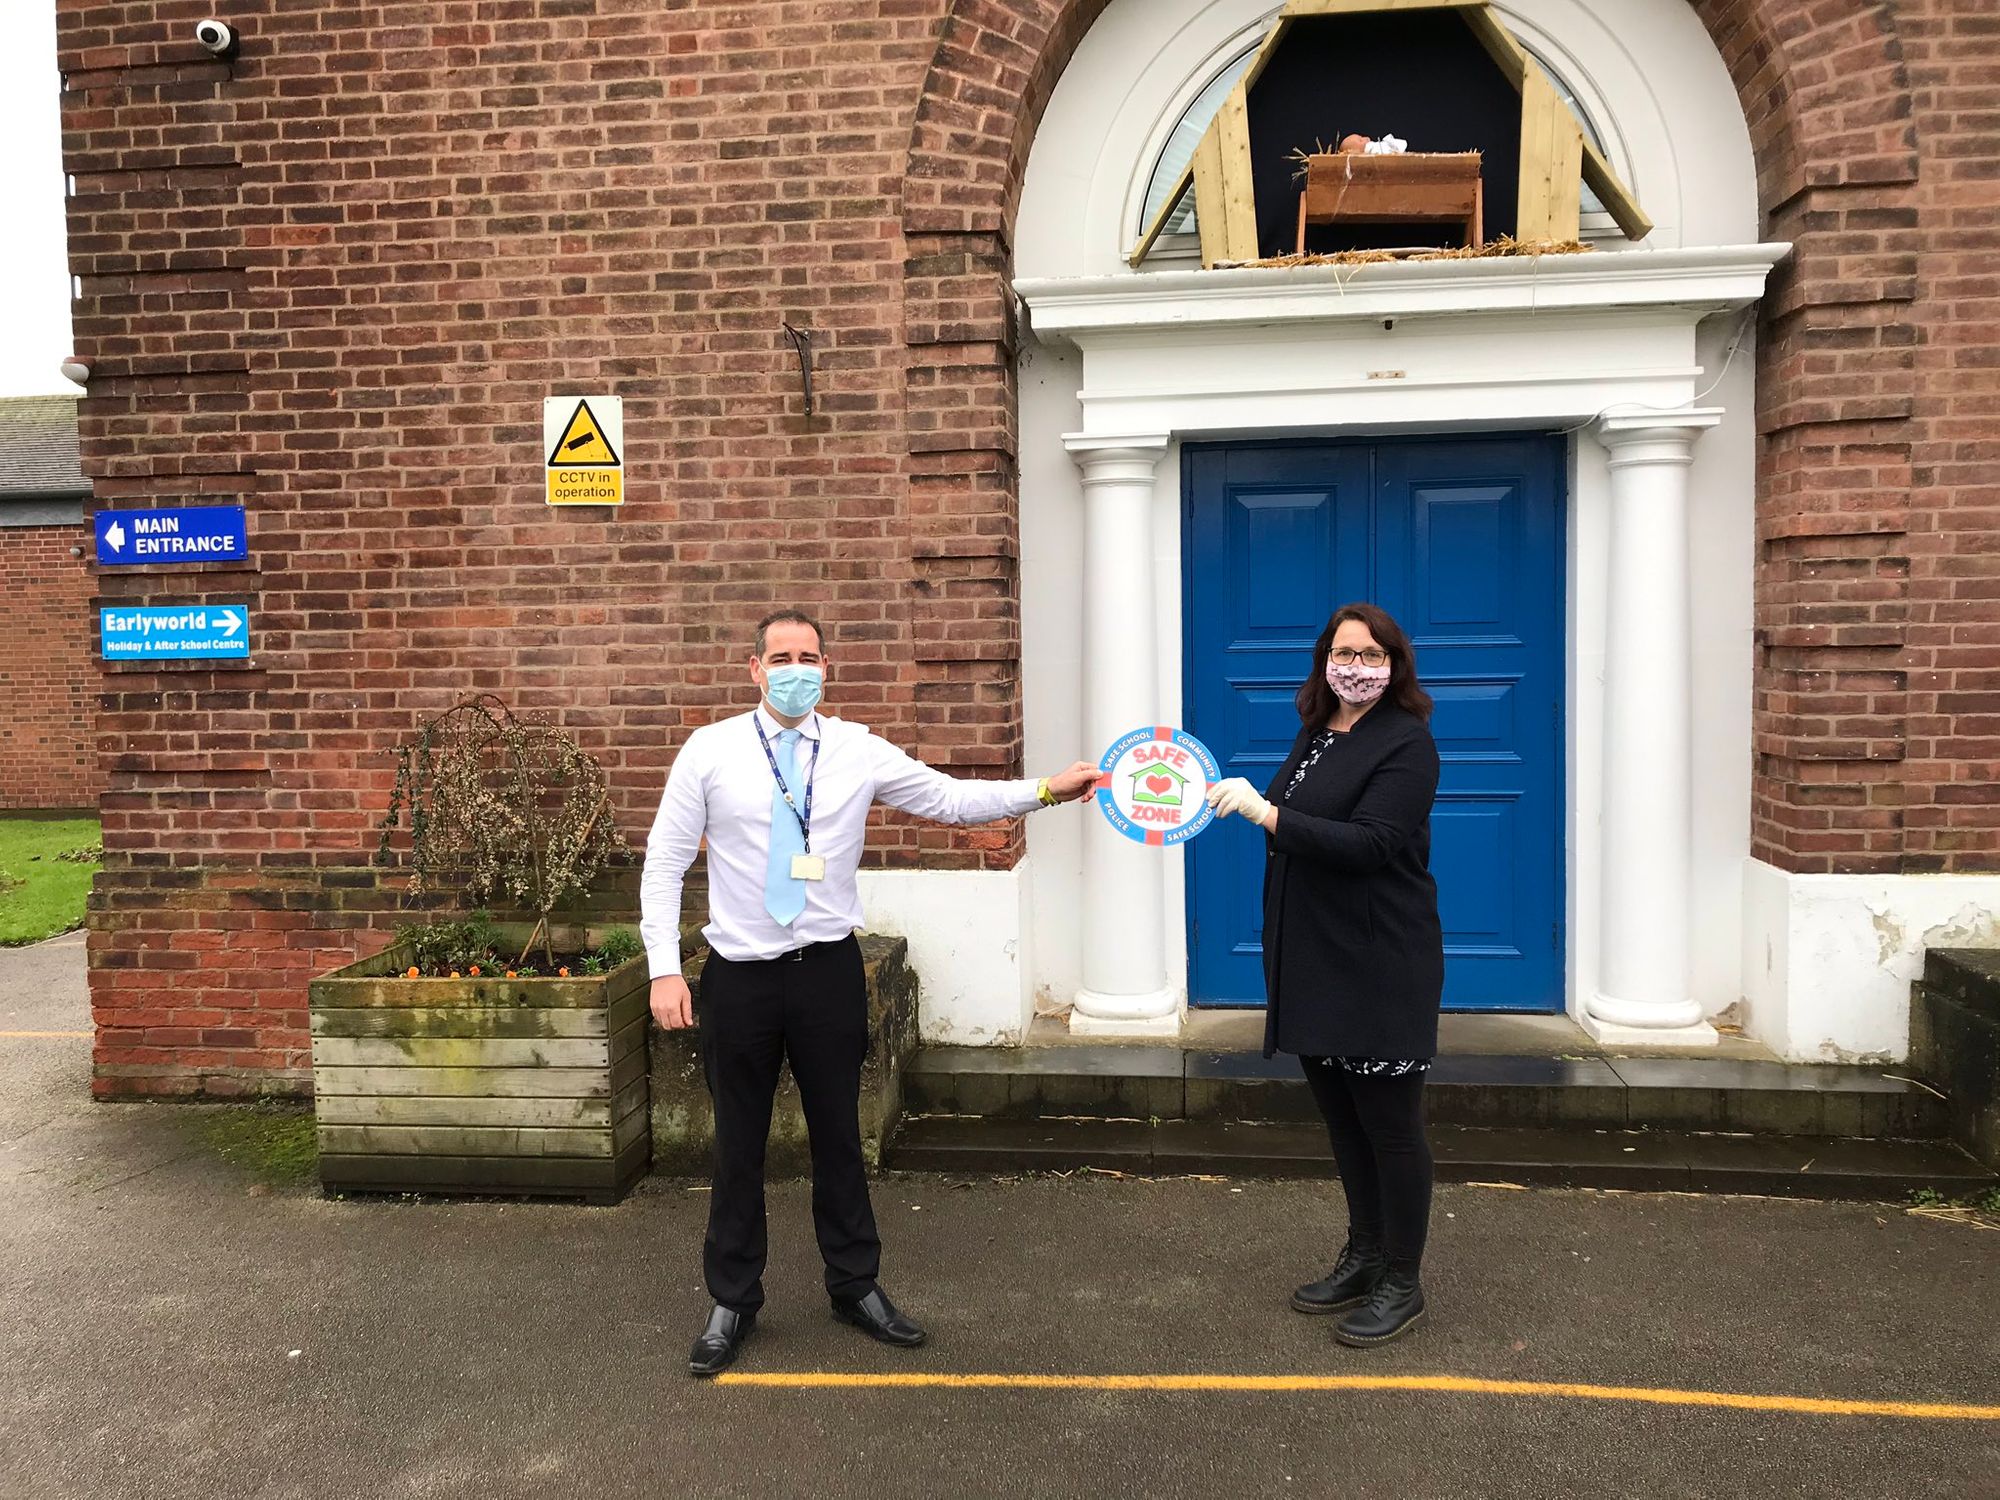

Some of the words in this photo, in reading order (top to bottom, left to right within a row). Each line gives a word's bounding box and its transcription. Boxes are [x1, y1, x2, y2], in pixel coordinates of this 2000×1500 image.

[559, 472, 595, 483] CCTV
[599, 472, 610, 482] in
[555, 487, 615, 500] operation
[134, 517, 179, 533] MAIN
[136, 536, 235, 554] ENTRANCE
[105, 612, 206, 636] Earlyworld
[106, 641, 143, 653] Holiday
[145, 641, 152, 651] &
[154, 640, 179, 651] After
[181, 639, 212, 650] School
[212, 639, 245, 649] Centre
[1104, 749, 1120, 769] SAFE
[1118, 731, 1151, 750] SCHOOL
[1132, 745, 1190, 769] SAFE
[1176, 735, 1217, 778] COMMUNITY
[1104, 802, 1130, 831] POLICE
[1130, 804, 1182, 825] ZONE
[1166, 828, 1190, 842] SAFE
[1188, 806, 1213, 833] SCHOO
